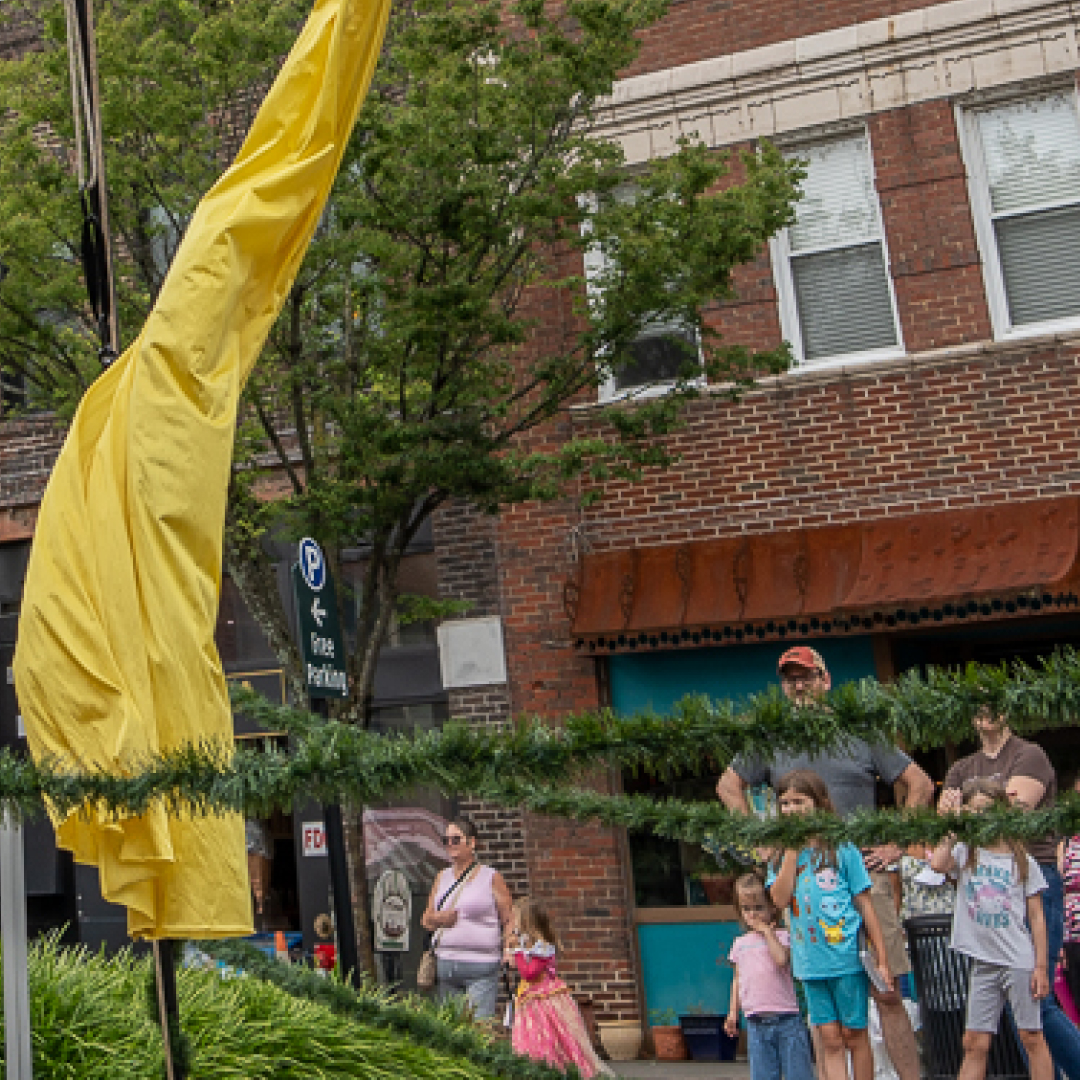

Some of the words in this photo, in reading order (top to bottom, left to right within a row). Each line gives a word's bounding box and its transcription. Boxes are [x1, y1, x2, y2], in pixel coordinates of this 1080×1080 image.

[305, 546, 321, 581] P
[311, 632, 335, 659] Free
[308, 663, 347, 696] Parking
